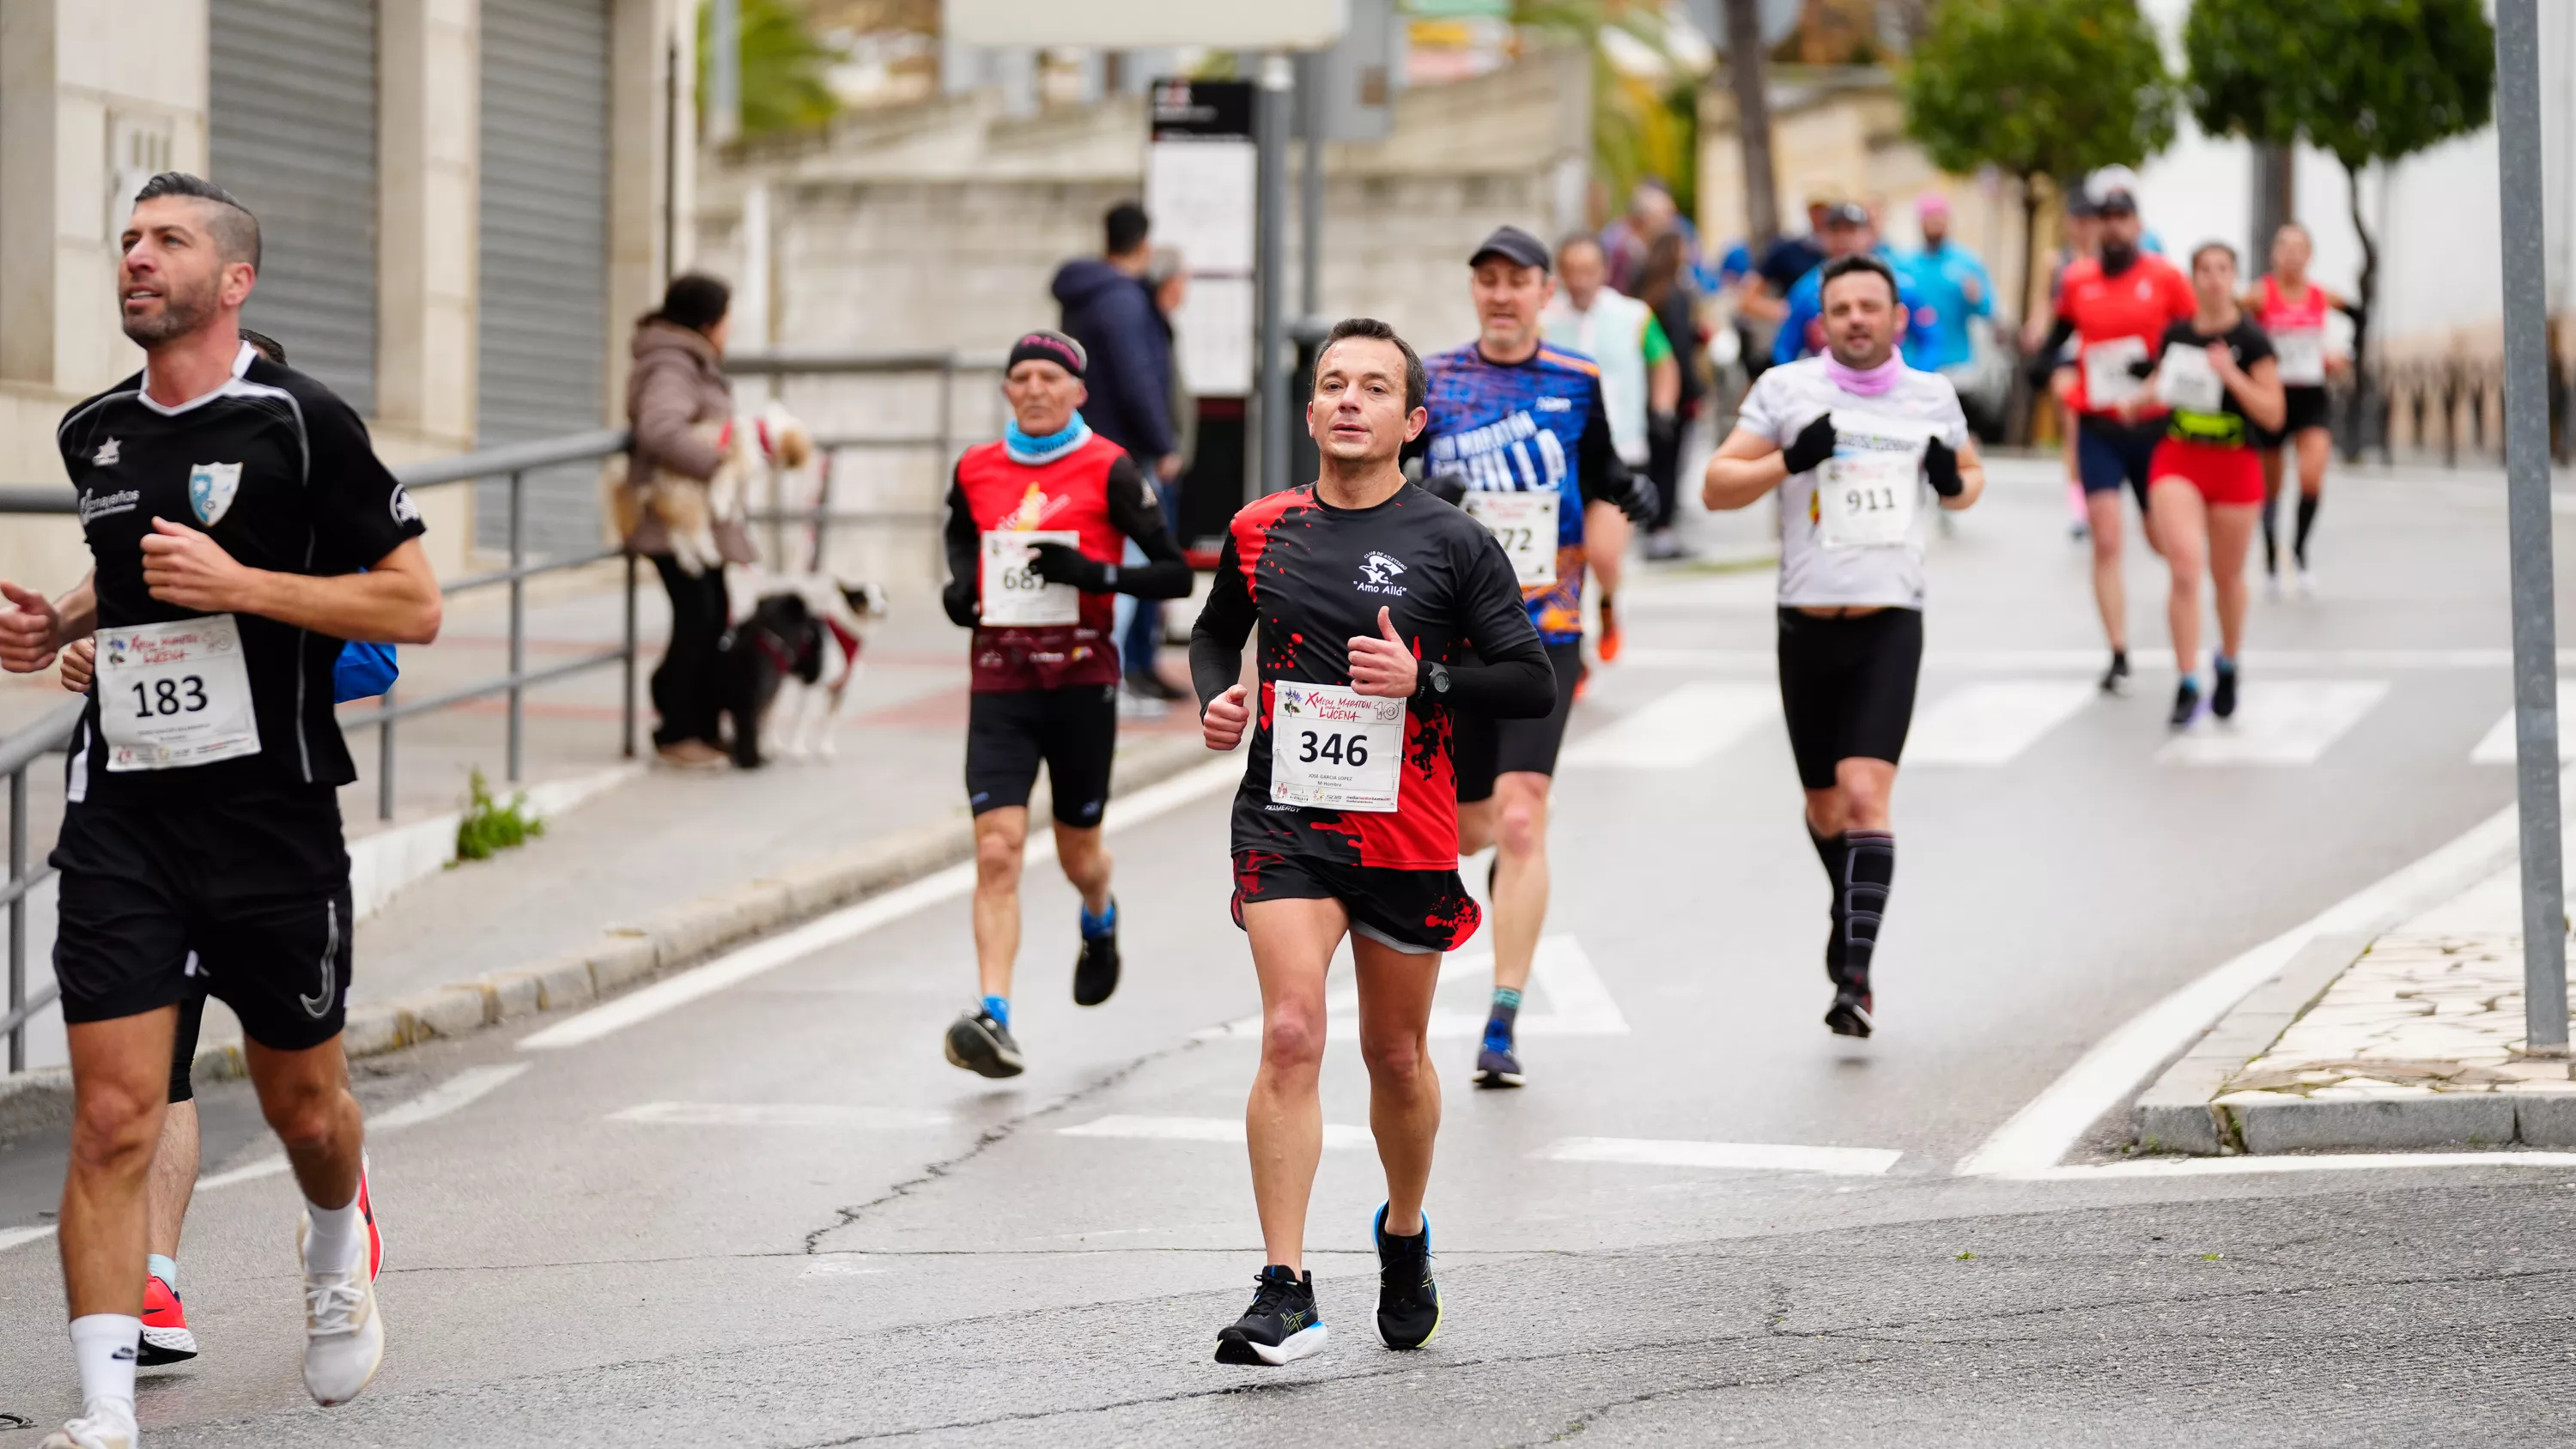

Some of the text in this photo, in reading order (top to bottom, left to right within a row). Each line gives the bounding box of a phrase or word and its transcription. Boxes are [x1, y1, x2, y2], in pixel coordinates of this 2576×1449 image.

[1847, 487, 1895, 516] 911
[1490, 528, 1532, 551] 72
[1364, 550, 1376, 559] CLUB
[1383, 554, 1408, 571] ATLETISMO
[131, 674, 209, 718] 183
[1319, 706, 1362, 722] LUCENA
[1299, 731, 1368, 767] 346
